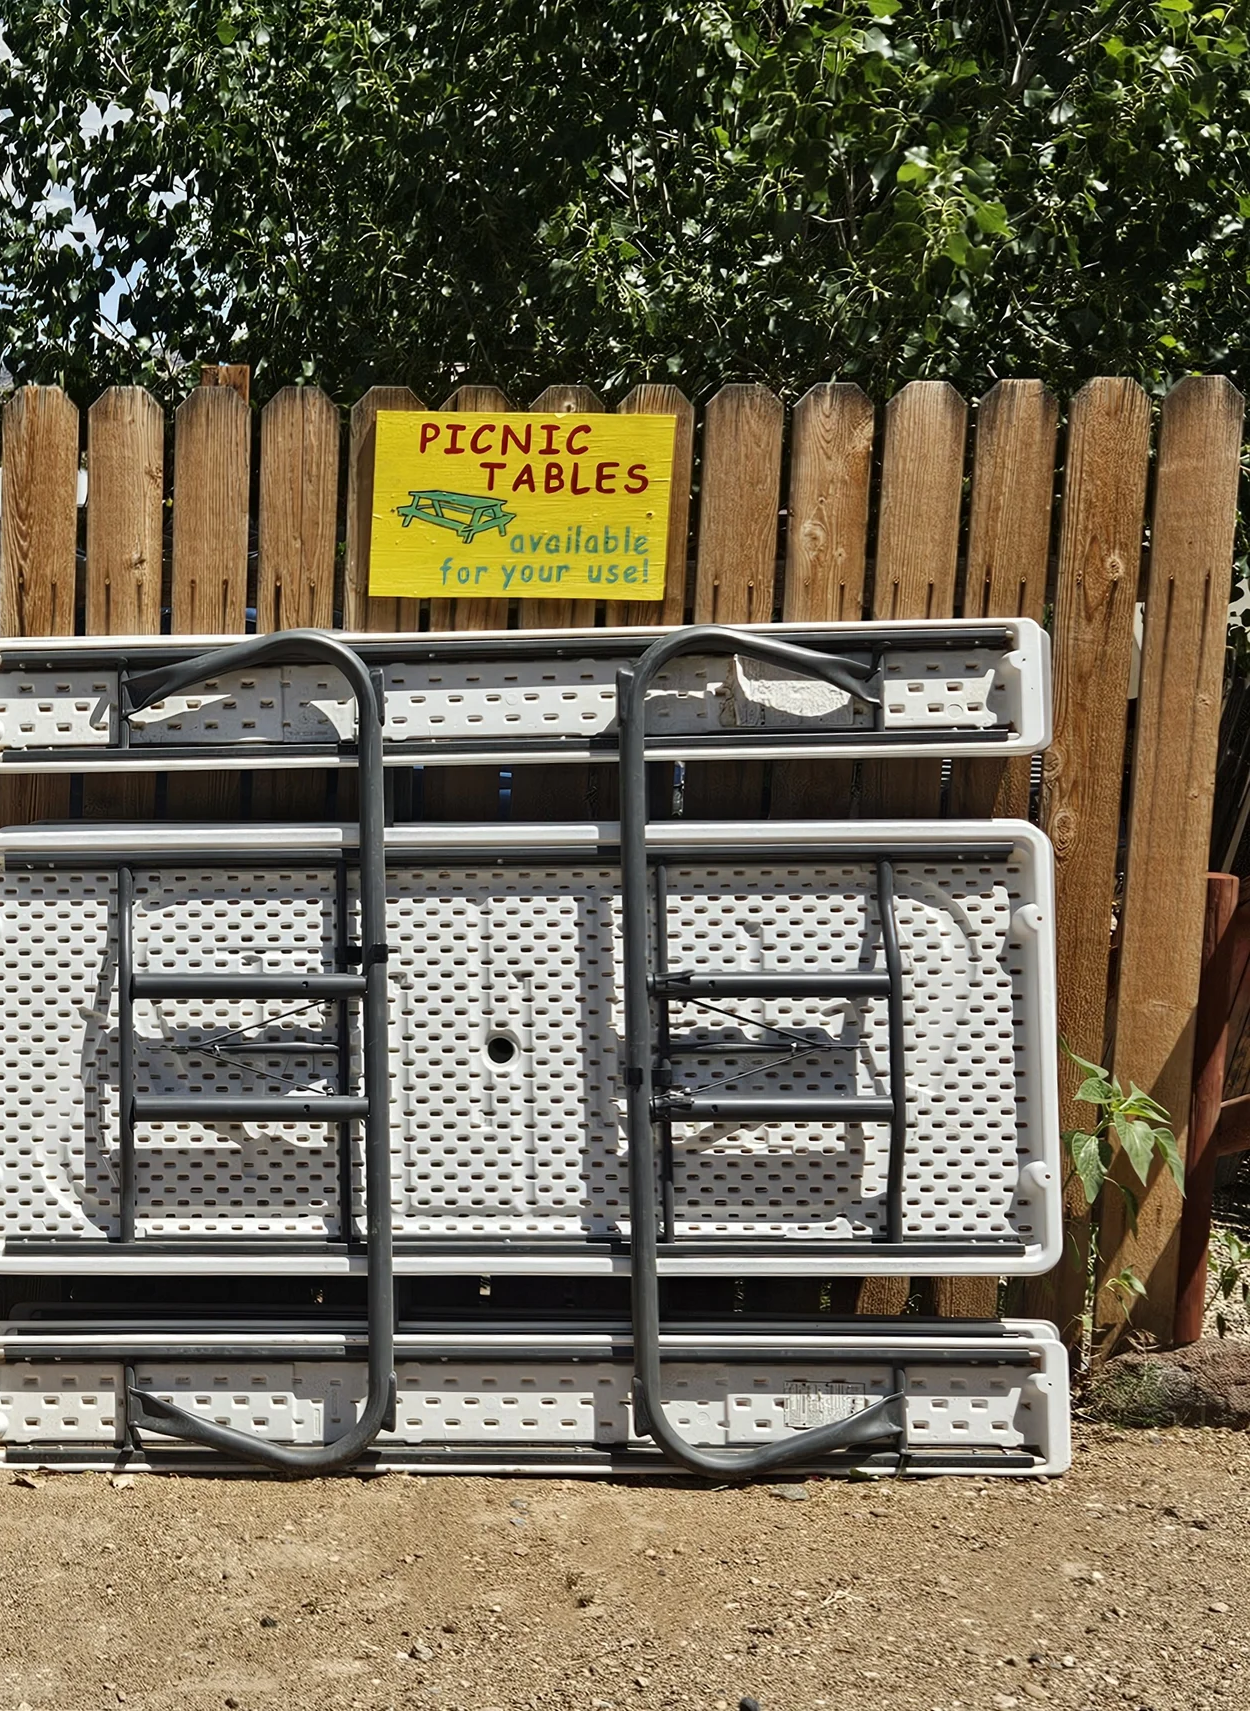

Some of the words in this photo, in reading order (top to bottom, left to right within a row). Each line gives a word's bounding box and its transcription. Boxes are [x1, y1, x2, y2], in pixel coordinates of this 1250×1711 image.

[419, 422, 592, 455] PICNIC
[479, 462, 649, 495] TABLES
[509, 525, 649, 555] available
[439, 557, 488, 586] for
[501, 563, 570, 590] your
[587, 558, 649, 584] use!
